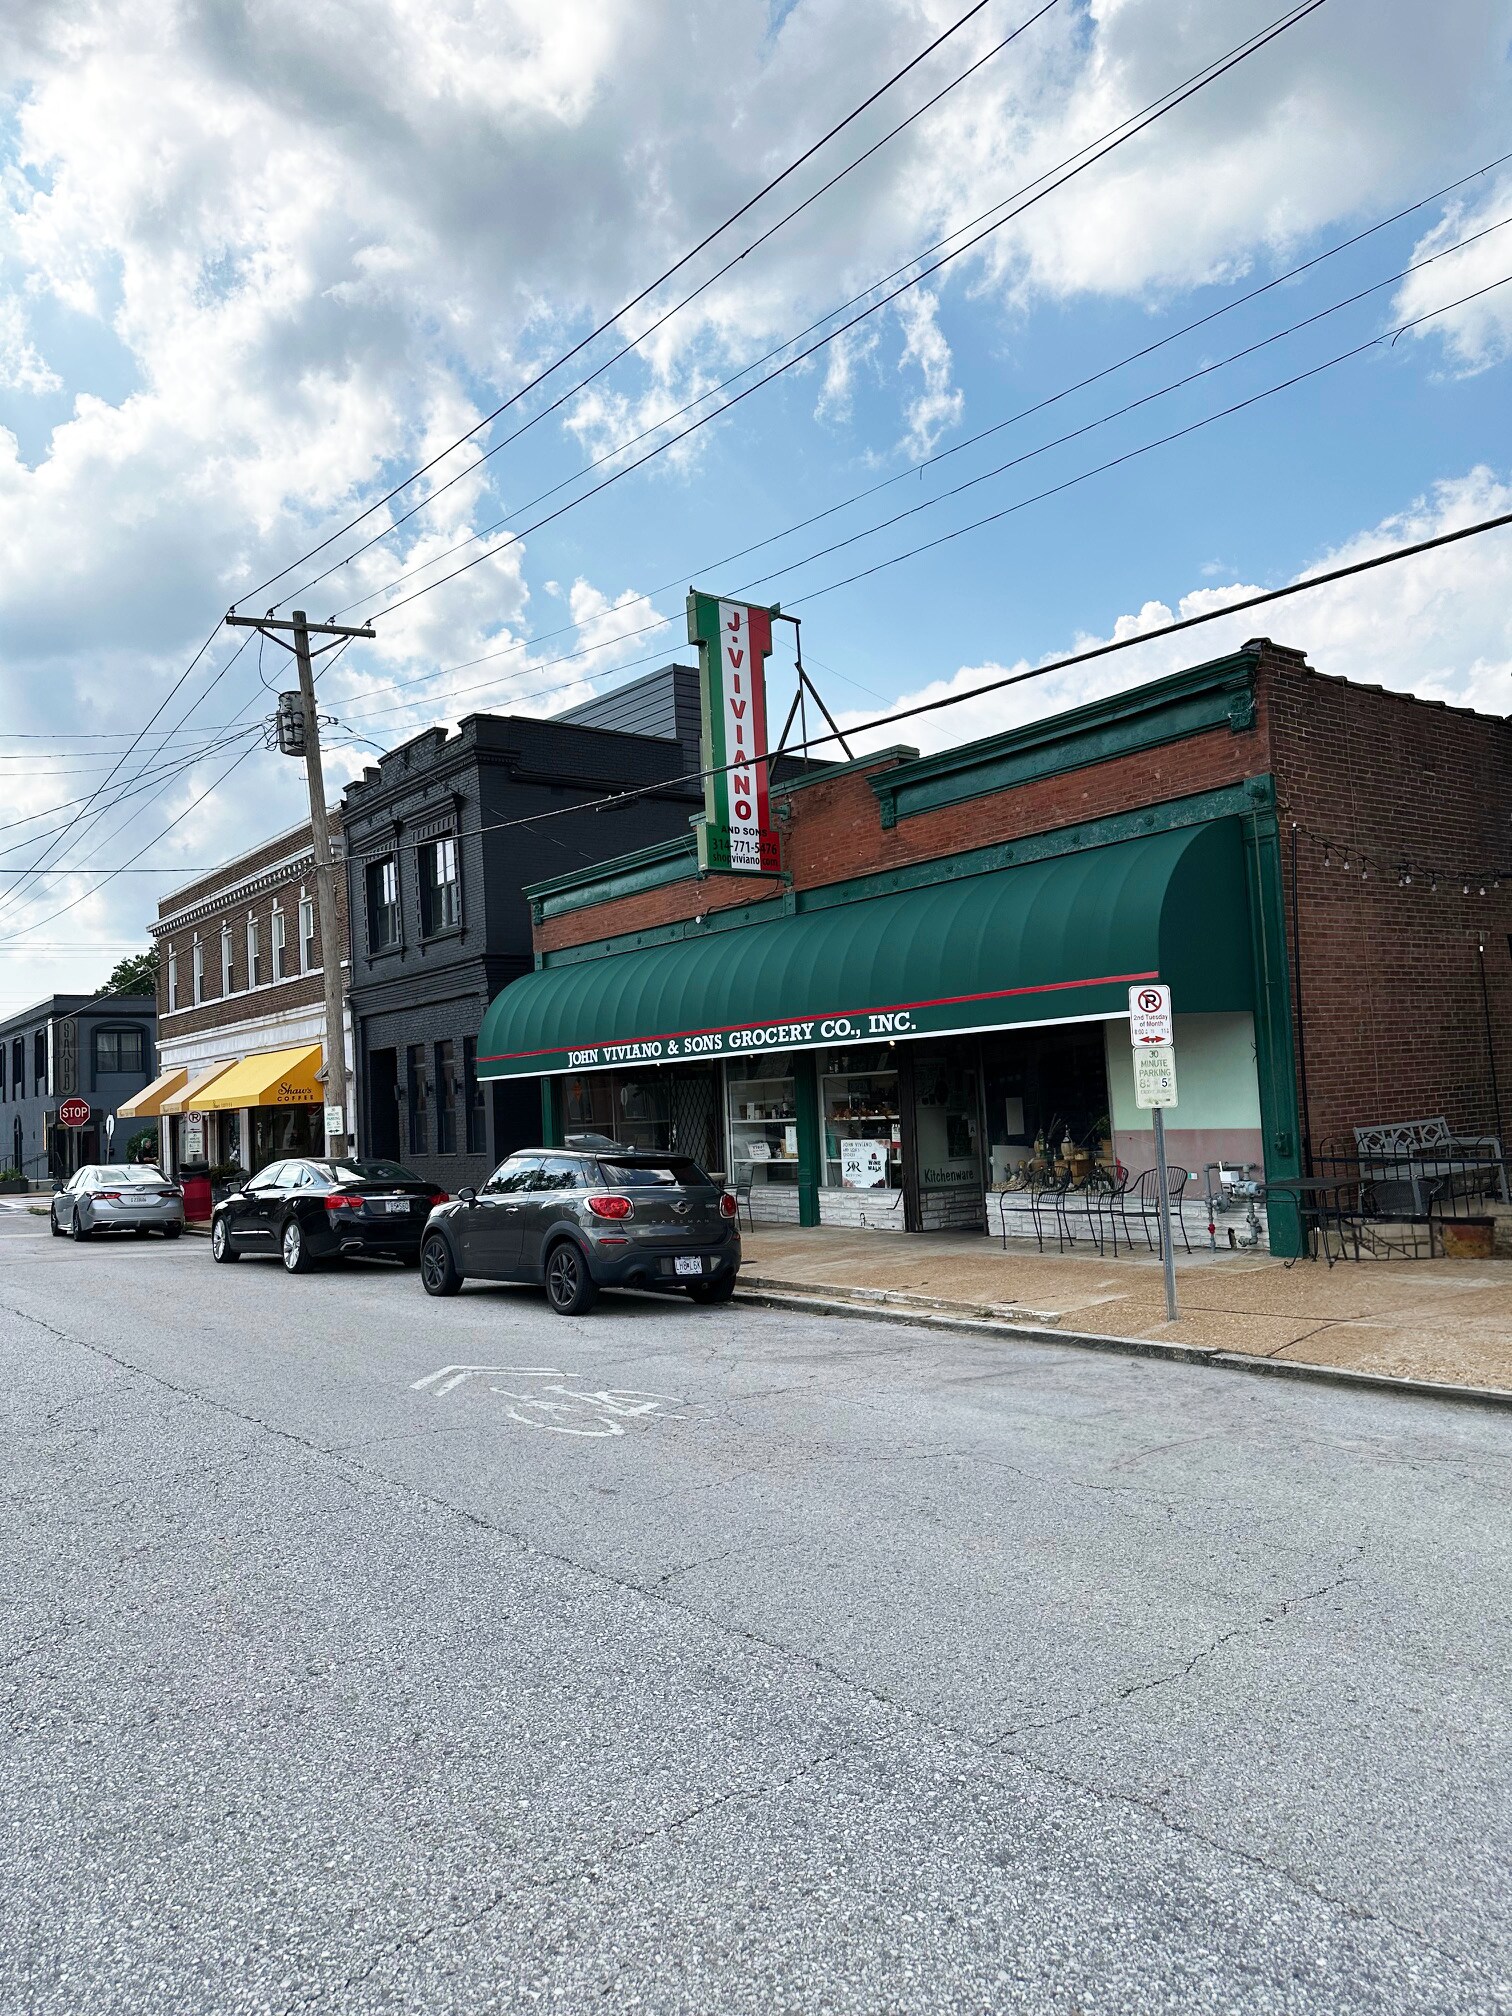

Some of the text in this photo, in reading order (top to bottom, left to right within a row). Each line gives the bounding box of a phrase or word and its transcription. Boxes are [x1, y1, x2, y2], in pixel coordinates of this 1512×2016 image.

[721, 825, 768, 837] AND SONS
[713, 838, 777, 855] 314-771-5476
[568, 1012, 917, 1067] JOHN VIVIANO & SONS GROCERY CO., INC.
[1149, 1050, 1159, 1058] 30
[1140, 1060, 1168, 1068] MINUTE
[1139, 1069, 1171, 1077] PARKING
[1161, 1077, 1168, 1087] 5
[278, 1082, 312, 1095] Shaw's
[62, 1107, 88, 1118] STOP
[924, 1168, 974, 1183] Kitchenware
